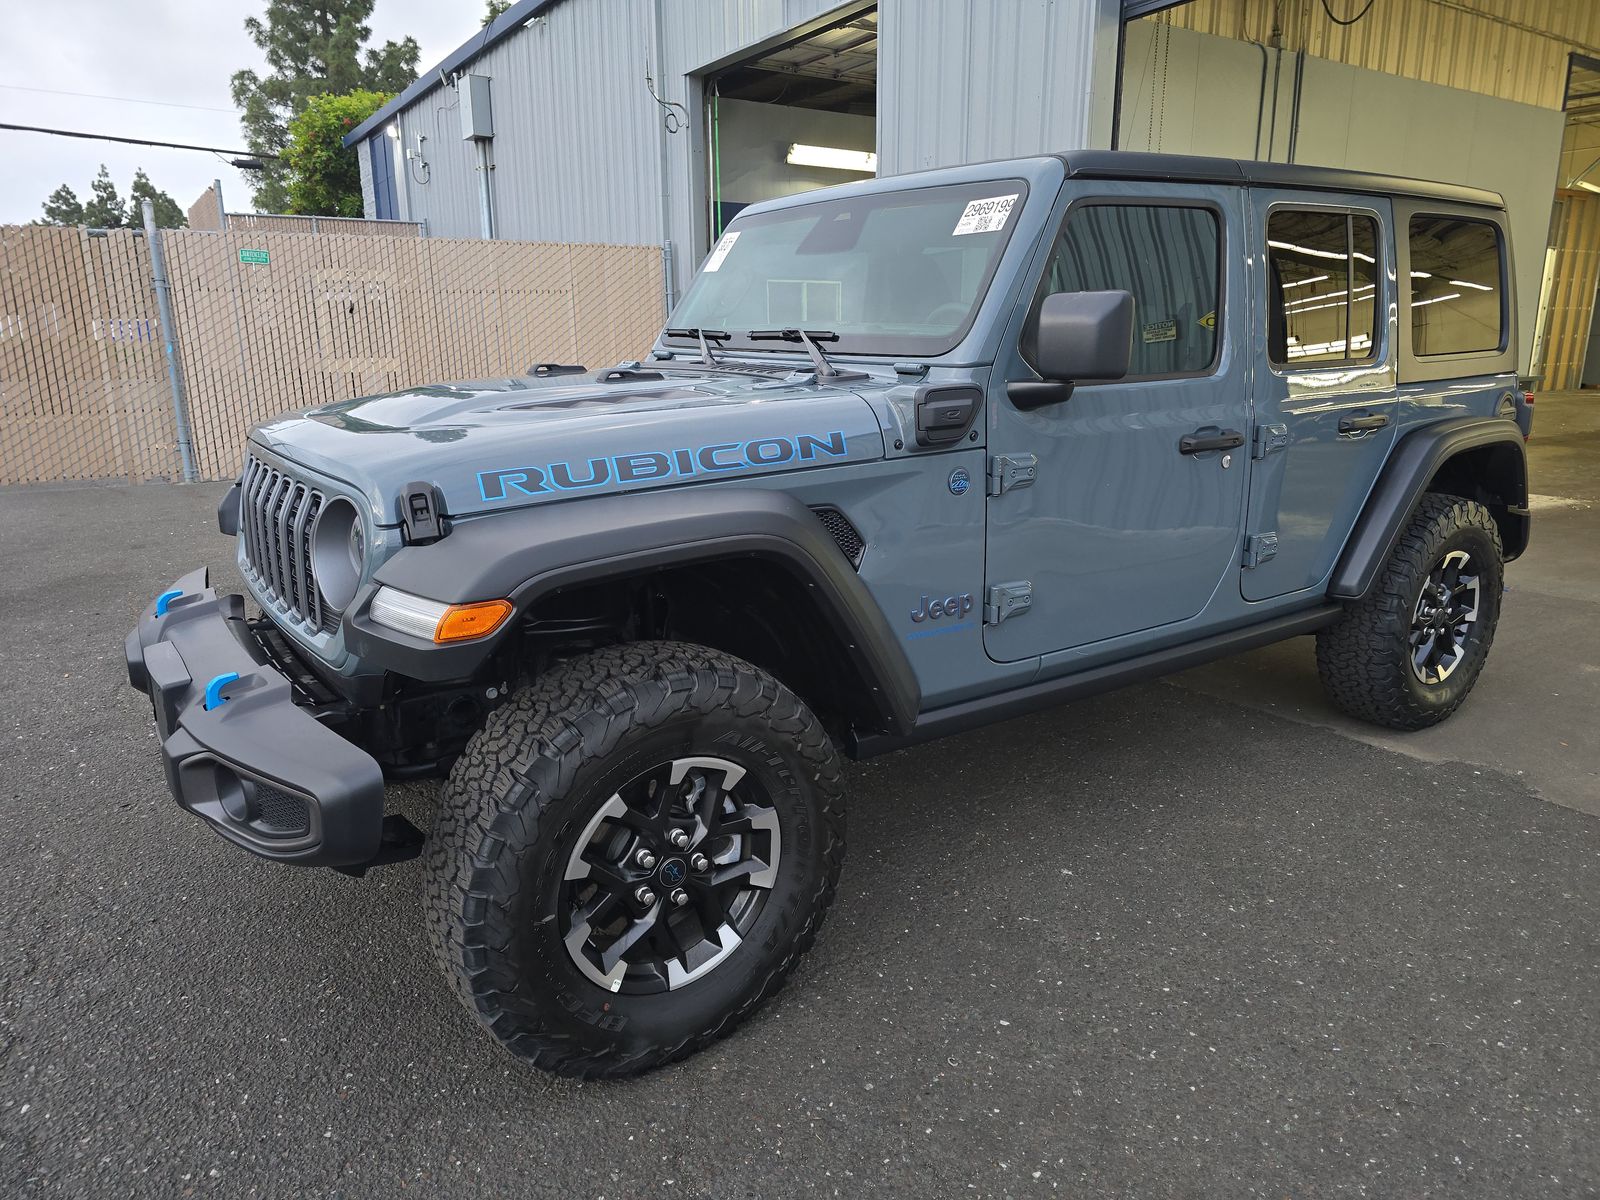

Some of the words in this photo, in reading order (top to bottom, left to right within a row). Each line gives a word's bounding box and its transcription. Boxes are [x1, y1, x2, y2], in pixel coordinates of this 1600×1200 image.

[964, 198, 1016, 218] 2969199
[476, 431, 848, 501] RUBICON
[911, 594, 974, 623] Jeep
